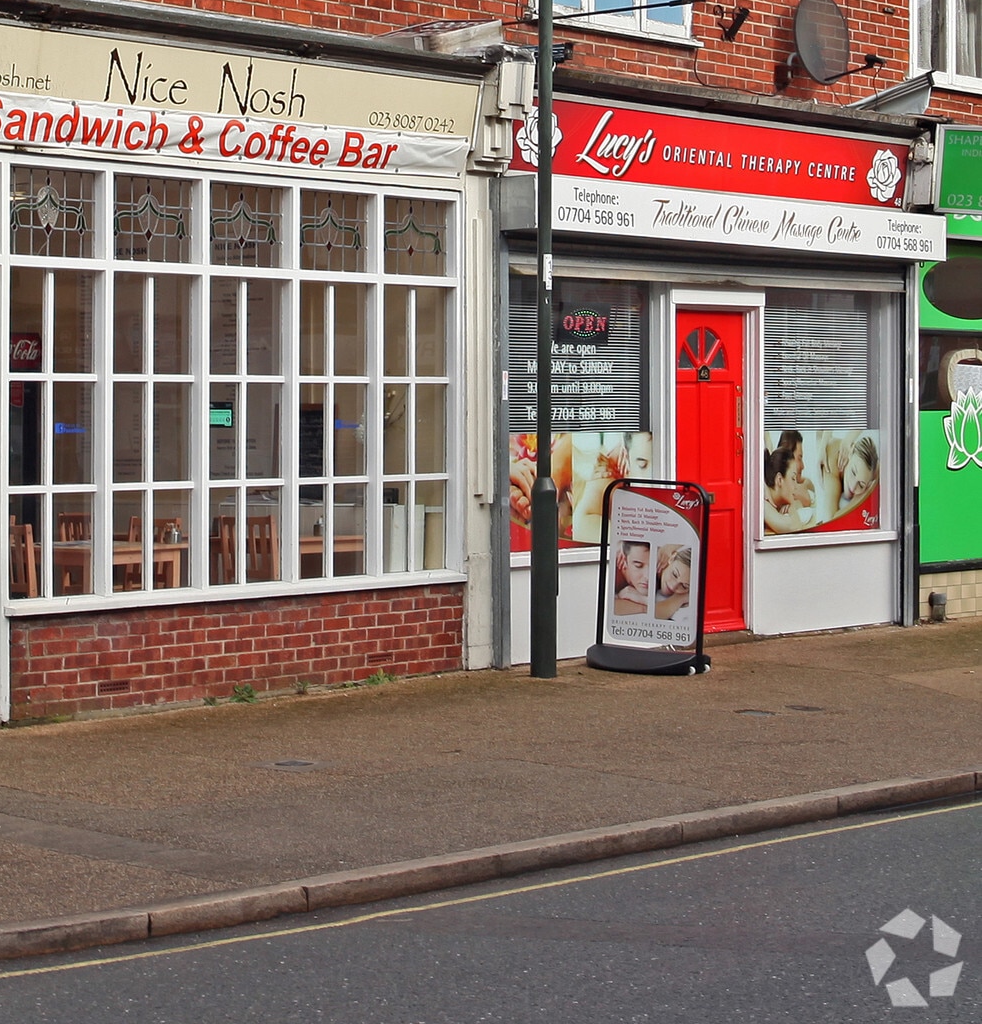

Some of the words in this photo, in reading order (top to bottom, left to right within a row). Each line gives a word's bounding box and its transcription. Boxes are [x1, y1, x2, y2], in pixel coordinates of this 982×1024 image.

[104, 47, 188, 105] Nice
[217, 62, 306, 118] Nosh
[178, 116, 205, 155] &
[219, 119, 329, 166] Coffee
[337, 131, 398, 170] Bar
[575, 110, 657, 177] Lucy's
[663, 145, 733, 169] ORIENTAL
[741, 154, 802, 176] THERAPY
[808, 162, 857, 182] CENTRE
[573, 187, 620, 207] Telephone:
[947, 193, 973, 208] 023
[558, 206, 591, 223] 07704
[595, 210, 614, 226] 568
[617, 213, 635, 227] 961
[652, 199, 722, 230] Traditional
[723, 204, 770, 235] Chinese
[771, 210, 823, 247] Massage
[827, 216, 862, 245] Centre
[887, 219, 922, 235] Telephone:
[876, 236, 901, 251] 07704
[903, 237, 918, 252] 568
[919, 238, 933, 253] 961
[563, 315, 608, 332] OPEN
[561, 345, 575, 355] are
[576, 344, 596, 358] open
[568, 361, 577, 374] to
[580, 360, 613, 374] SUNDAY
[561, 381, 580, 393] until
[578, 408, 596, 421] 568
[599, 408, 616, 420] 961
[675, 495, 700, 510] Lucy's
[611, 626, 625, 635] Tel:
[627, 628, 653, 638] 07704
[656, 630, 673, 640] 568
[675, 632, 691, 642] 961
